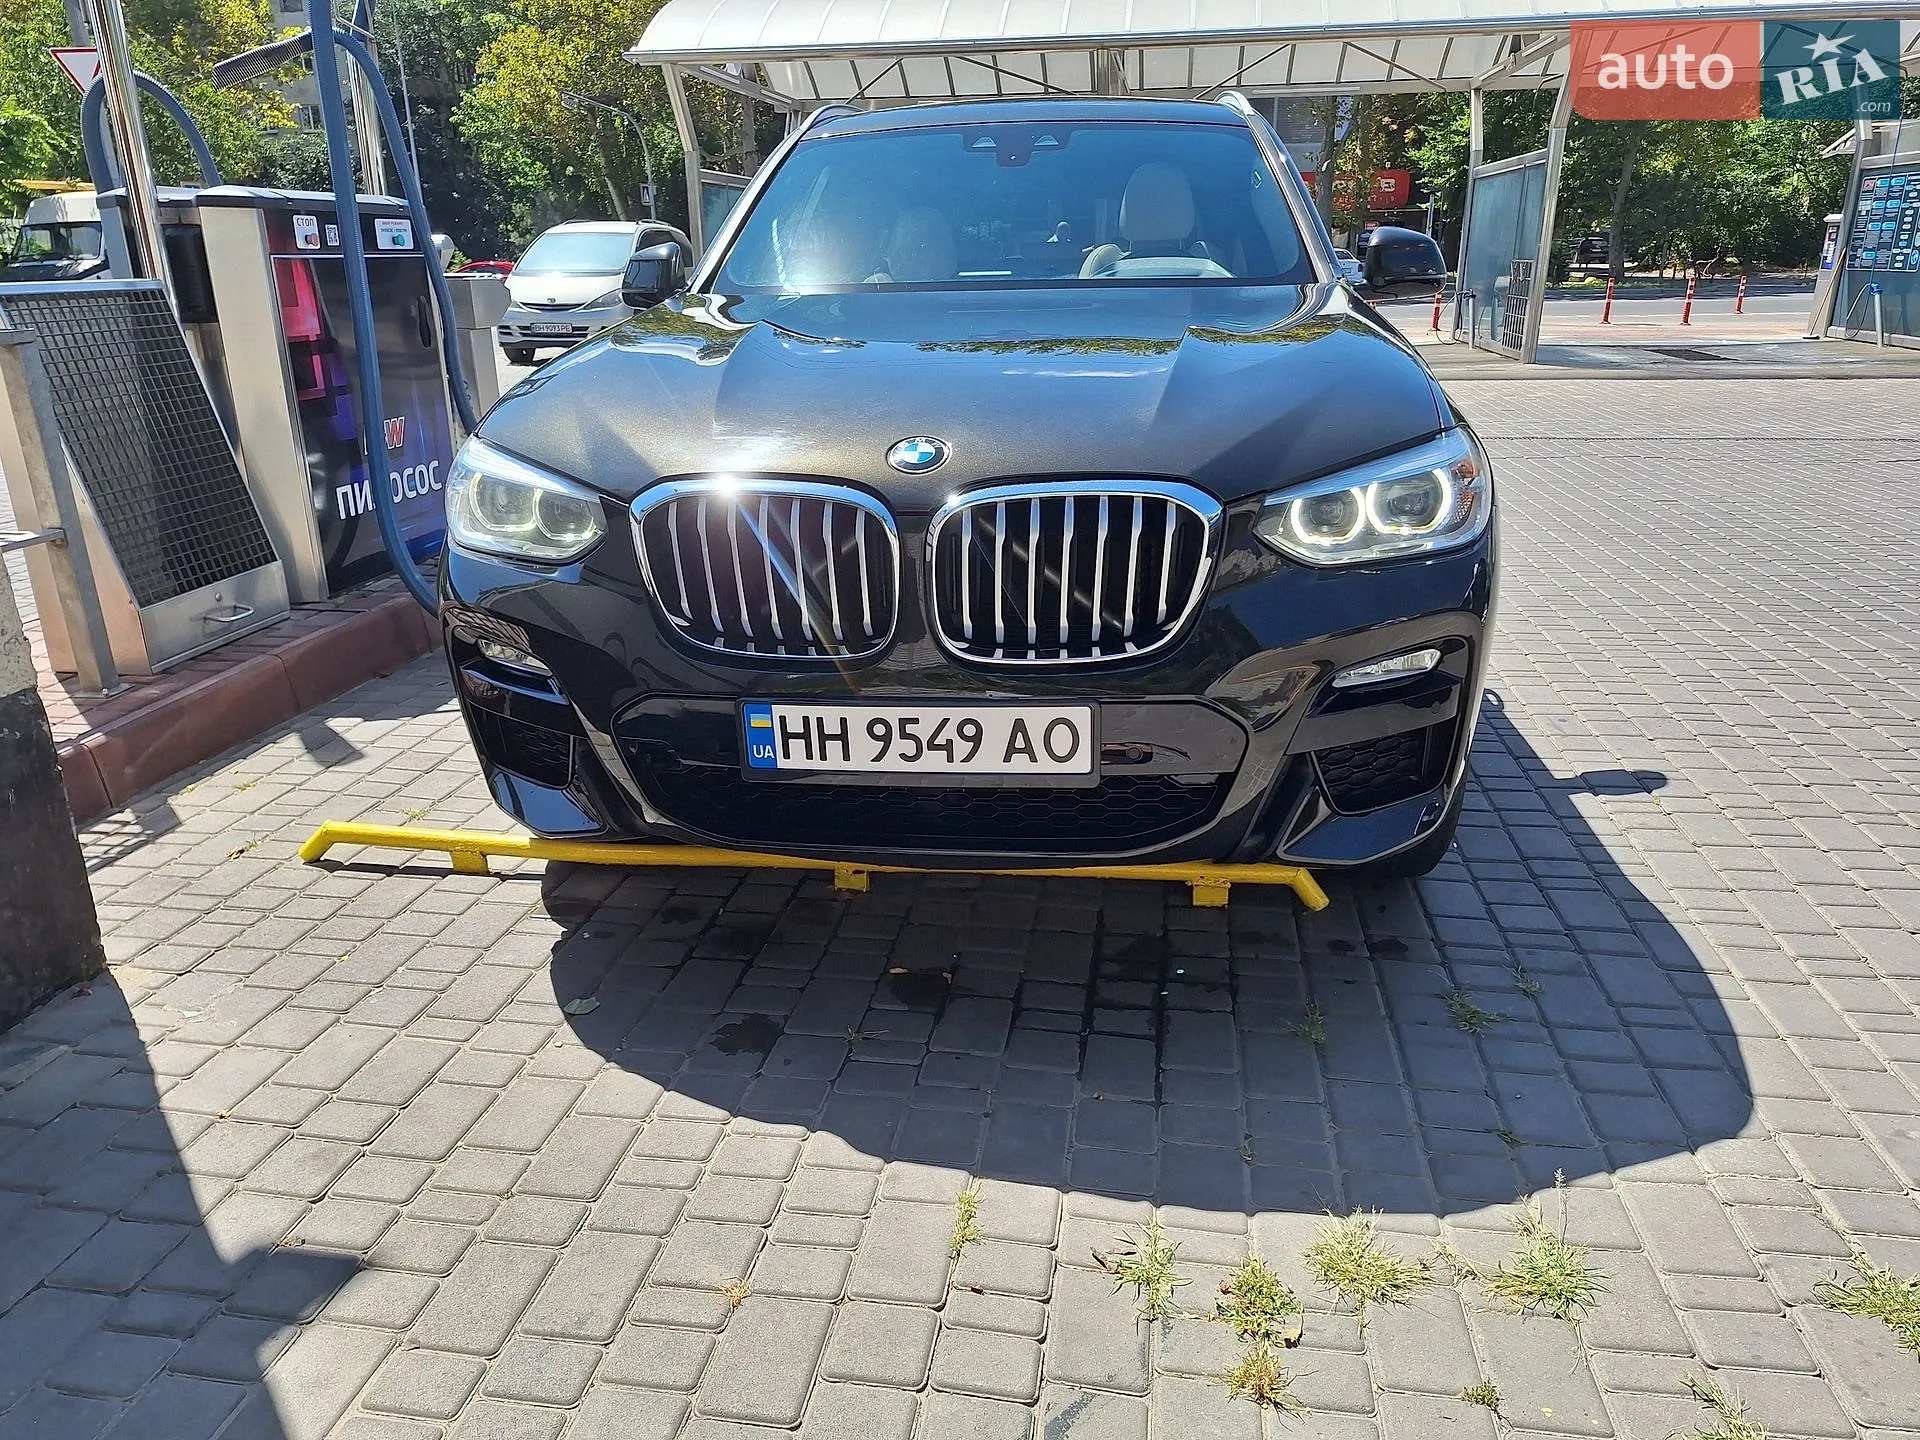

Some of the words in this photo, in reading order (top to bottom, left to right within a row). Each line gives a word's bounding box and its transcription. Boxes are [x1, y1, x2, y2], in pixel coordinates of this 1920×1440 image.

[296, 217, 316, 227] СТОП
[336, 460, 443, 520] ПИОСОС
[753, 745, 774, 759] UA
[779, 715, 850, 762] HH
[866, 717, 984, 763] 9549
[1003, 717, 1080, 763] AO
